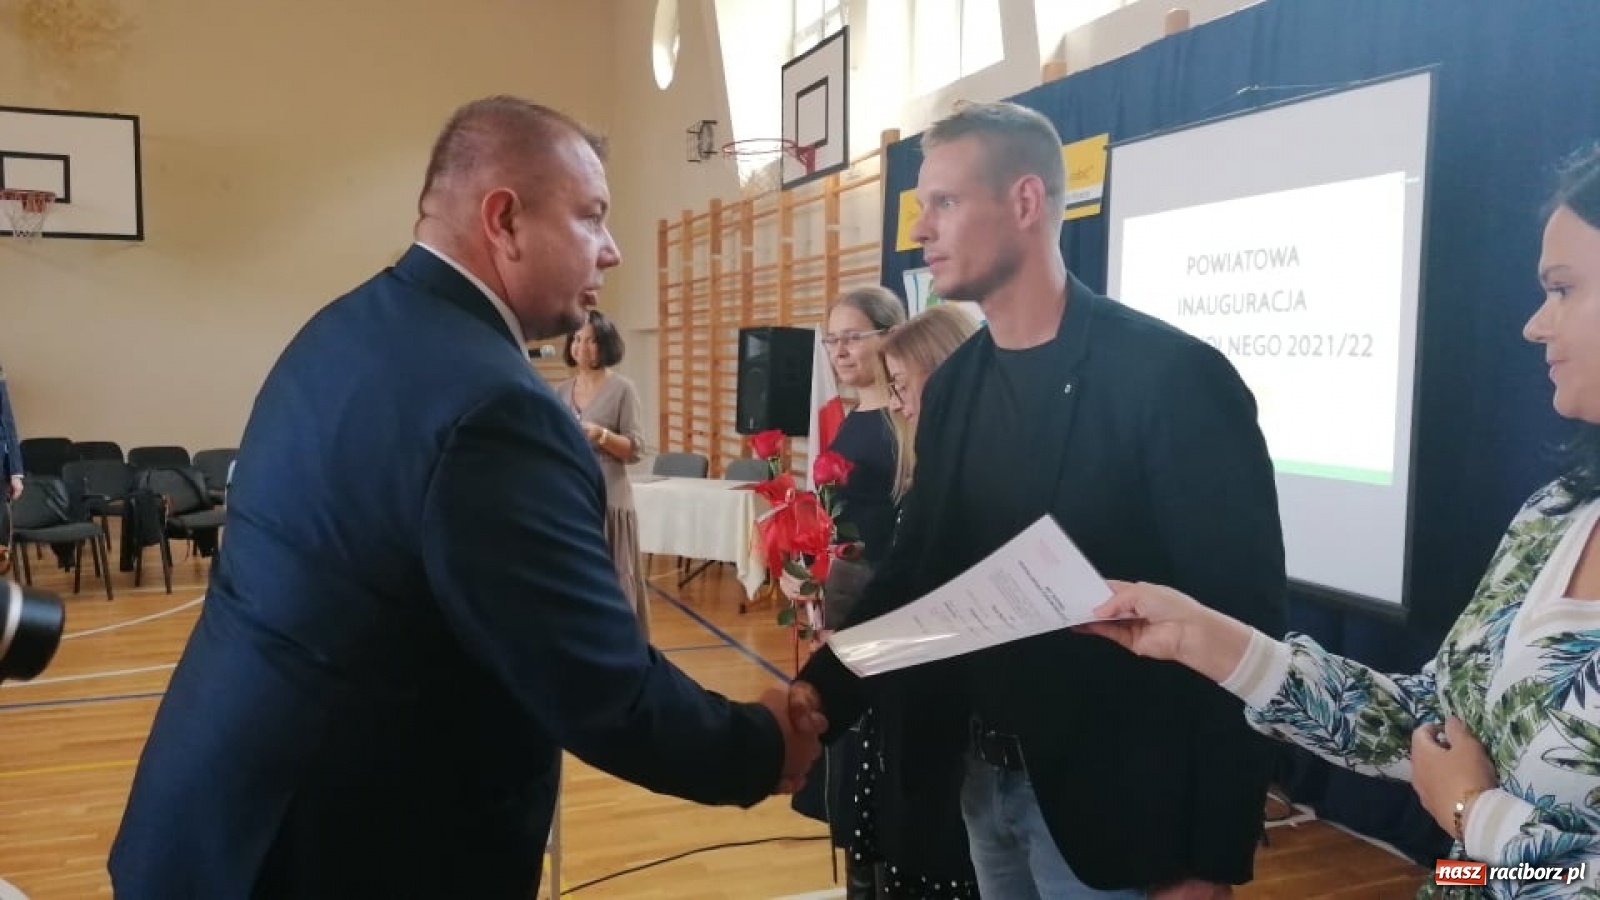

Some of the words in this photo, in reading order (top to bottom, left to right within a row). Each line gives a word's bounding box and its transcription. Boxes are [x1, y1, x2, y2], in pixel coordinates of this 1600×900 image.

[1186, 245, 1301, 276] POWIATOWA
[1177, 289, 1308, 316] INAUGURACJA
[1286, 332, 1374, 359] 2021/22
